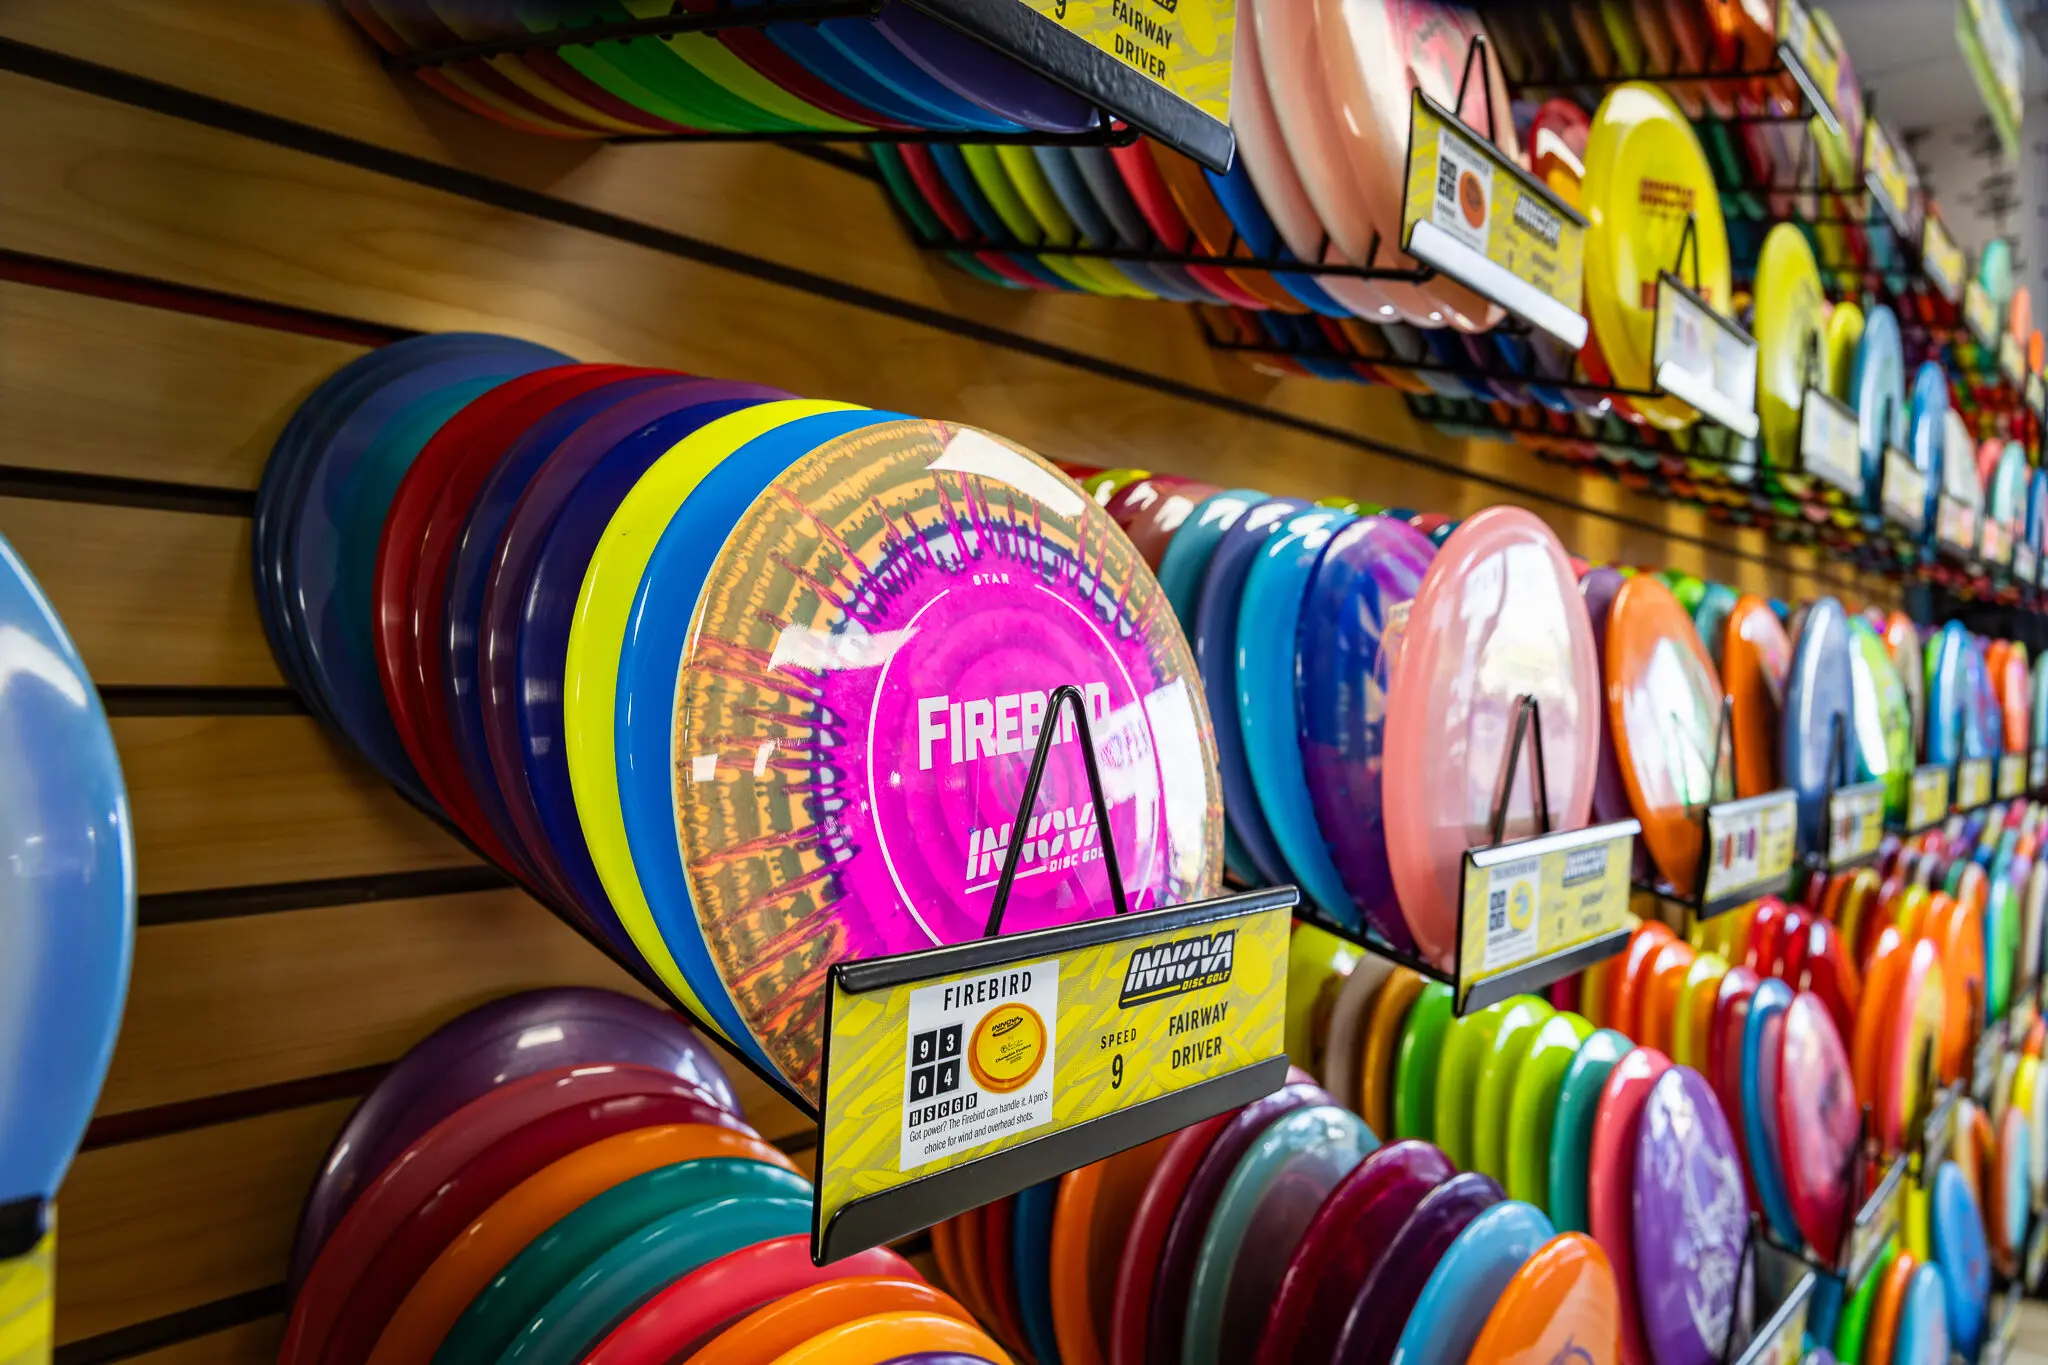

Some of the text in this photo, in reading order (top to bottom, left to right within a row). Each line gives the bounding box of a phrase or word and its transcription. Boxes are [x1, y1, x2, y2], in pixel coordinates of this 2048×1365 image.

[1112, 0, 1172, 50] FAIRWAY
[1115, 33, 1166, 80] DRIVER
[972, 572, 1010, 586] STAR
[1049, 846, 1106, 873] DISC GOL
[1124, 934, 1233, 993] INNOVA
[1181, 970, 1230, 991] DISC GOLF
[944, 971, 1032, 1011] FIREBIRD
[1169, 1001, 1229, 1037] FAIRWAY
[920, 1033, 955, 1059] 9 3
[1100, 1028, 1137, 1049] SPEED
[1172, 1036, 1222, 1070] DRIVER
[918, 1068, 953, 1094] 0 4
[1111, 1054, 1124, 1090] 9
[909, 1130, 922, 1143] Got
[923, 1121, 947, 1140] power?
[949, 1118, 961, 1130] The
[961, 1110, 985, 1126] Firebird
[986, 1107, 998, 1118] can
[999, 1099, 1020, 1113] handle
[1028, 1095, 1033, 1105] A
[1033, 1090, 1049, 1106] pro's
[924, 1111, 1034, 1155] choice for wind and overhead shots.
